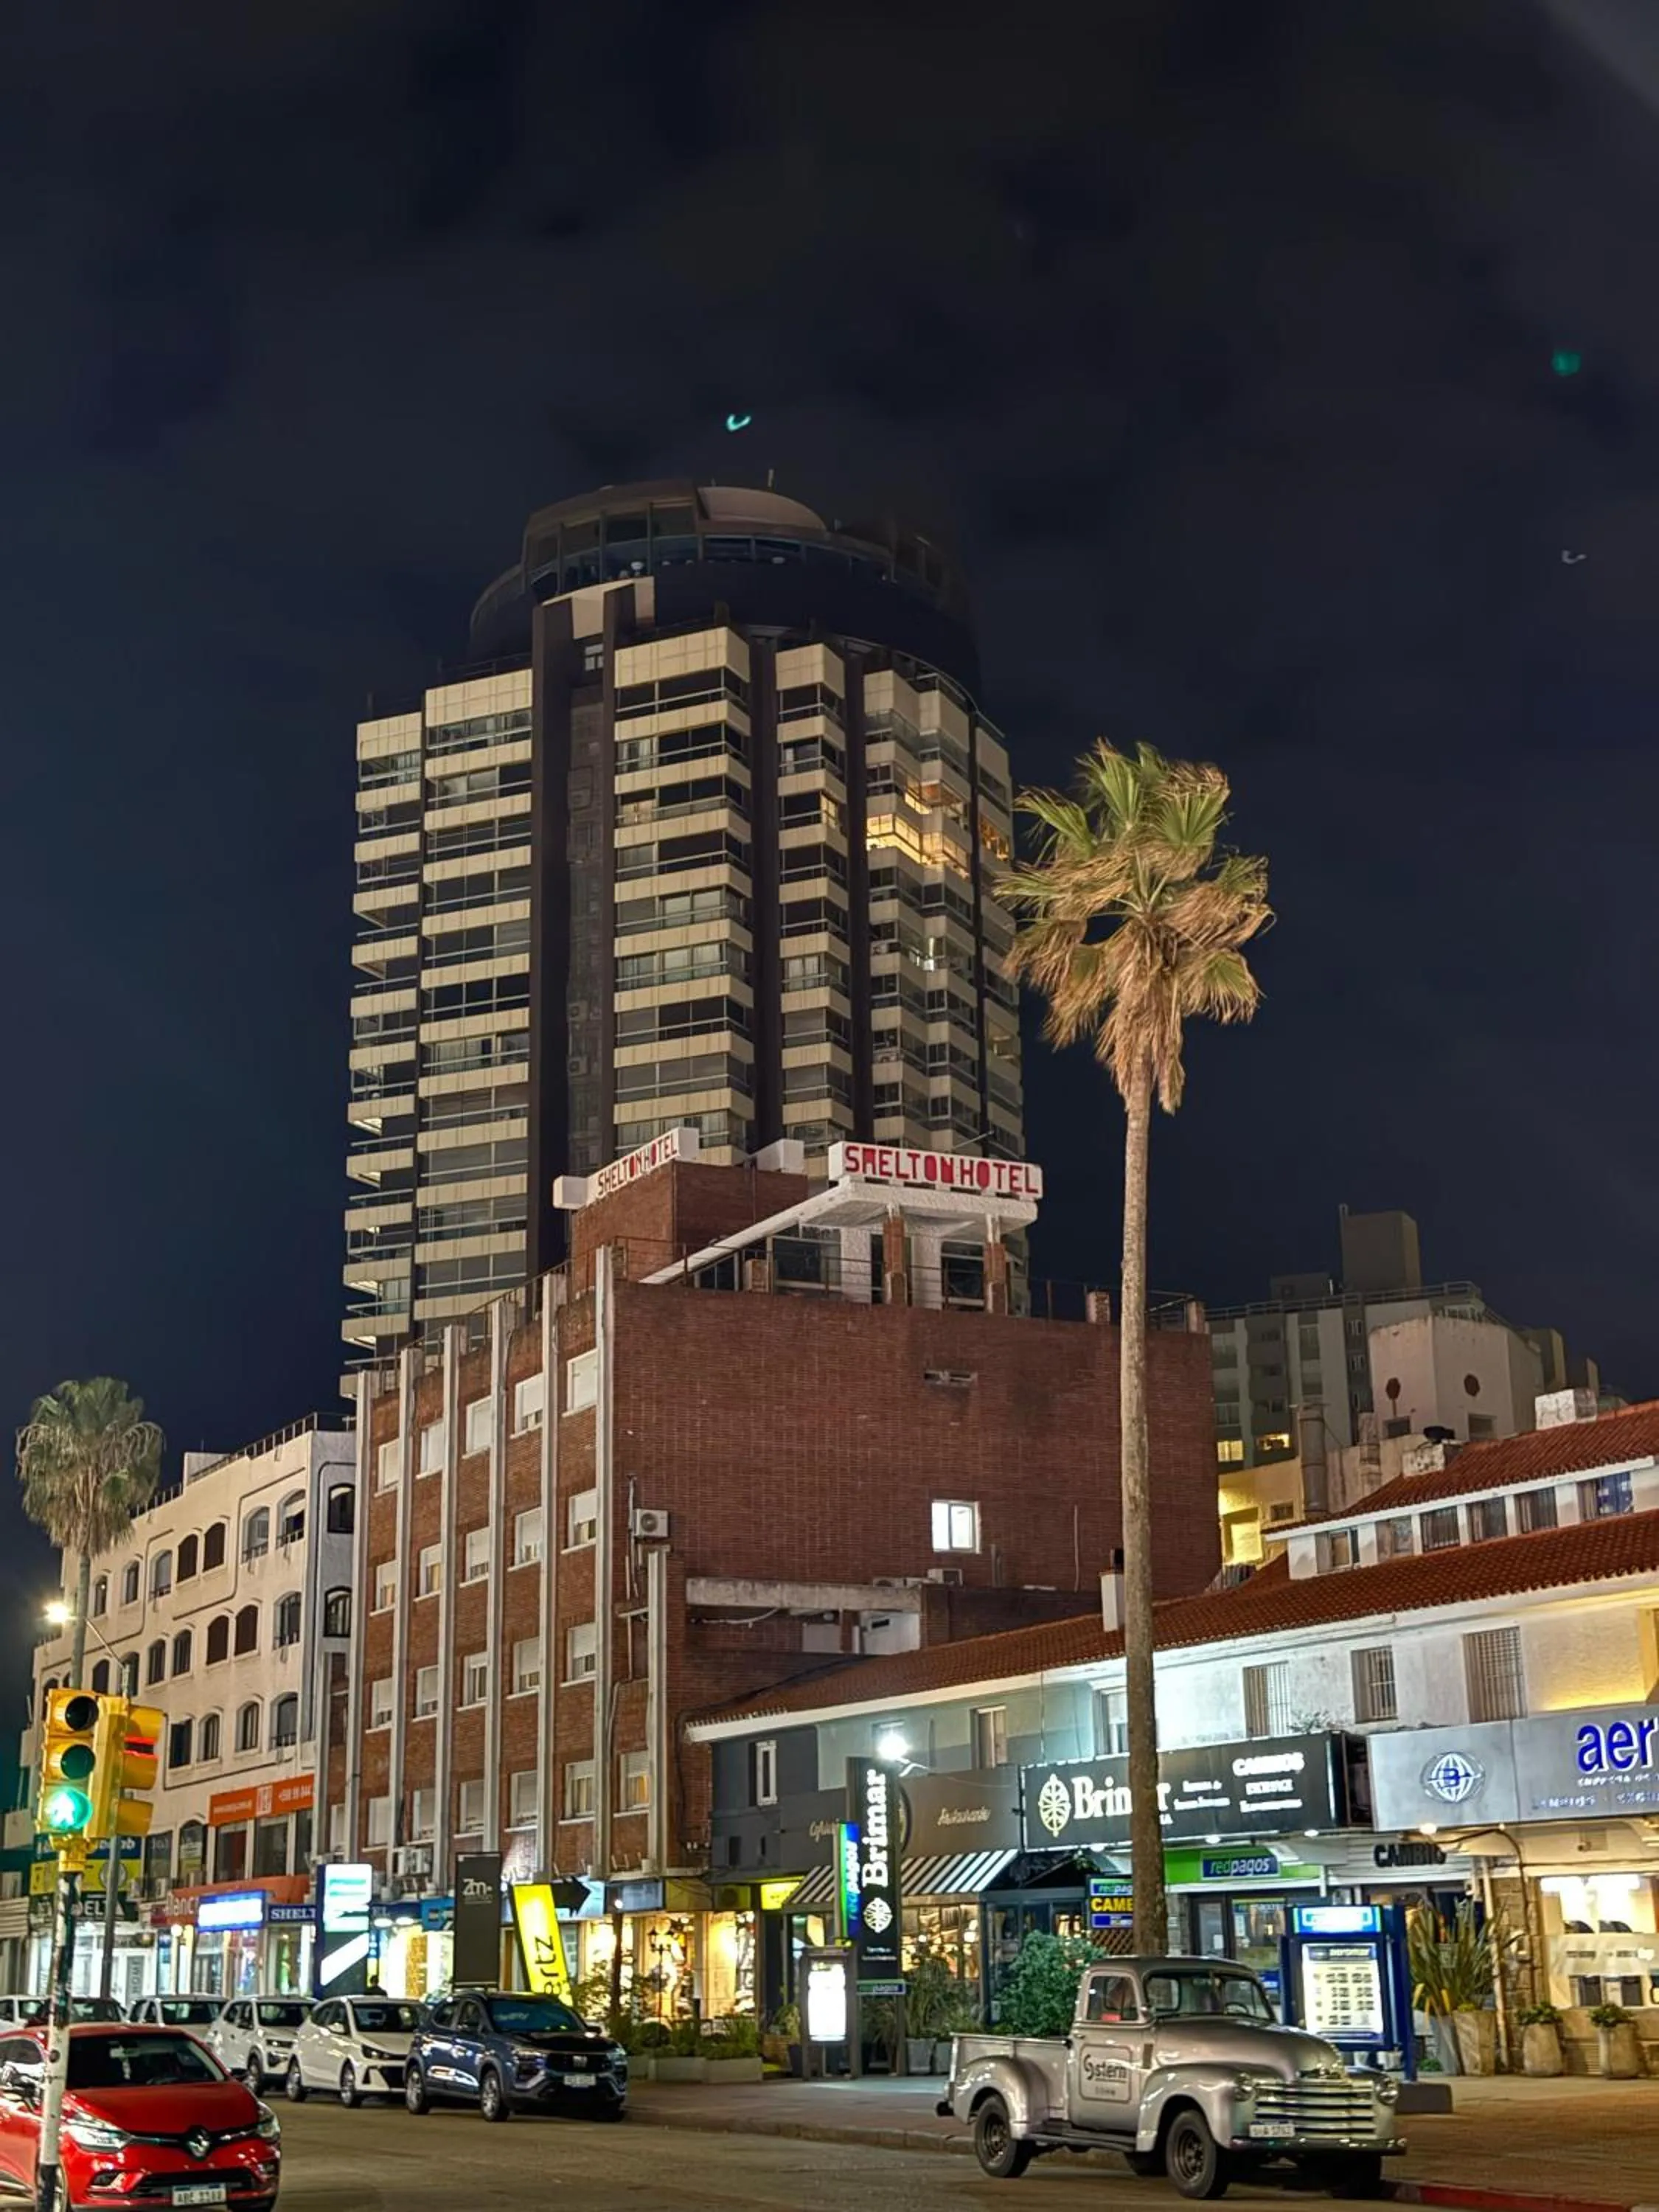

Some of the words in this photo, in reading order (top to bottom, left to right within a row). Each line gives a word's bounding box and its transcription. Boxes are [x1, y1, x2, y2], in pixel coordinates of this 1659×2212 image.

[598, 1152, 642, 1194] SHELTON
[642, 1134, 677, 1172] HOTEL
[844, 1145, 954, 1183] SHELTON
[959, 1158, 1039, 1194] HOTEL
[1071, 1775, 1172, 1820] Brimr
[861, 1769, 888, 1888] Brimar
[1210, 1858, 1270, 1877] redpagos
[535, 1935, 563, 1994] ertz
